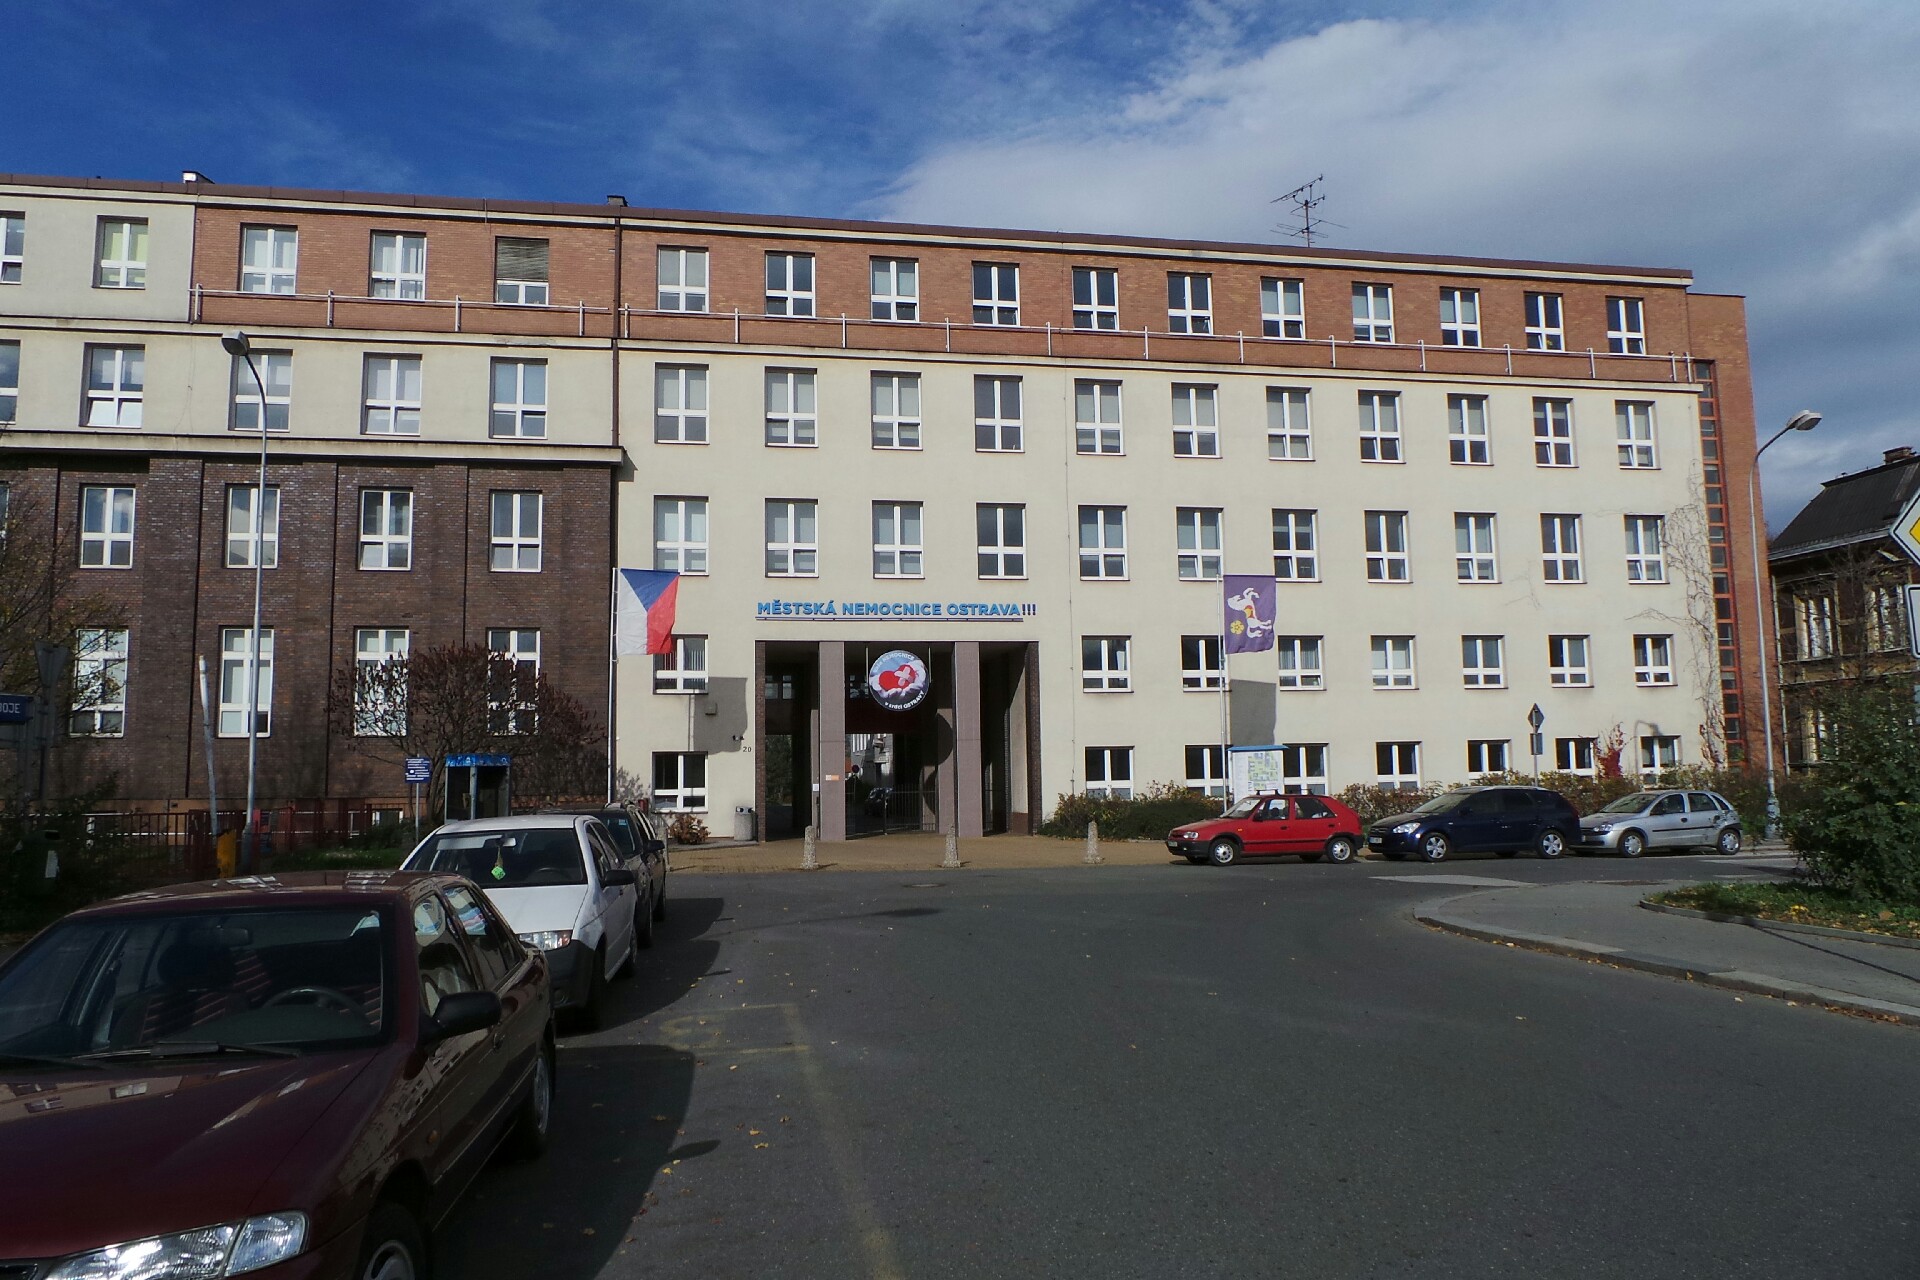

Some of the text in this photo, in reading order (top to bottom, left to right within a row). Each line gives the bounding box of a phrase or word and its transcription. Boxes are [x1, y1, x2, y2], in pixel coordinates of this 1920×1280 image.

[757, 599, 837, 615] MĚSTSKÁ
[842, 602, 942, 616] NEMOCNICE
[903, 690, 925, 709] OSTRAVY
